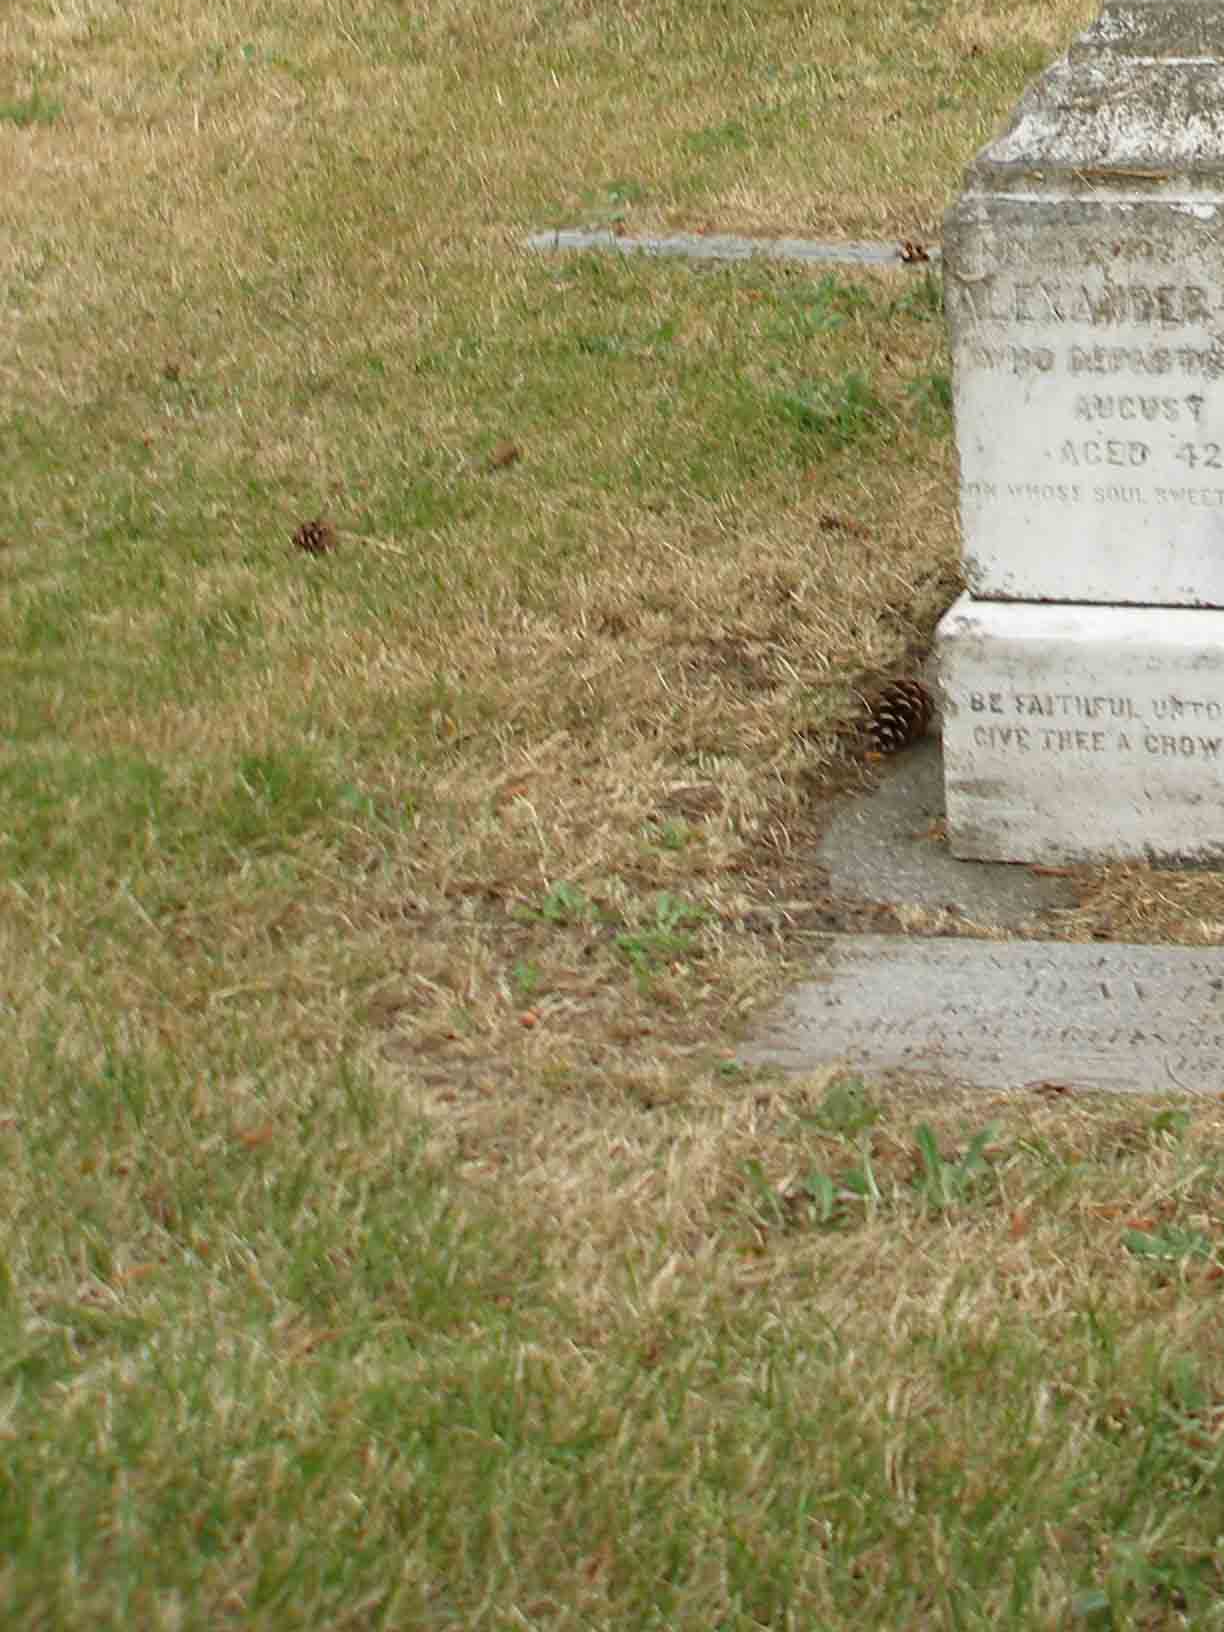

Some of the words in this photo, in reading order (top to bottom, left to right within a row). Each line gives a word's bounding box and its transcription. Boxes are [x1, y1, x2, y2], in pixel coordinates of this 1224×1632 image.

[1074, 392, 1205, 422] AUGUST
[1093, 484, 1149, 505] SOUL
[970, 692, 1004, 715] BE
[1014, 692, 1143, 720] FAITHFUL
[1152, 696, 1222, 721] UNTO
[974, 723, 1031, 753] GIVE
[1041, 727, 1106, 753] THEE
[1118, 732, 1134, 753] A
